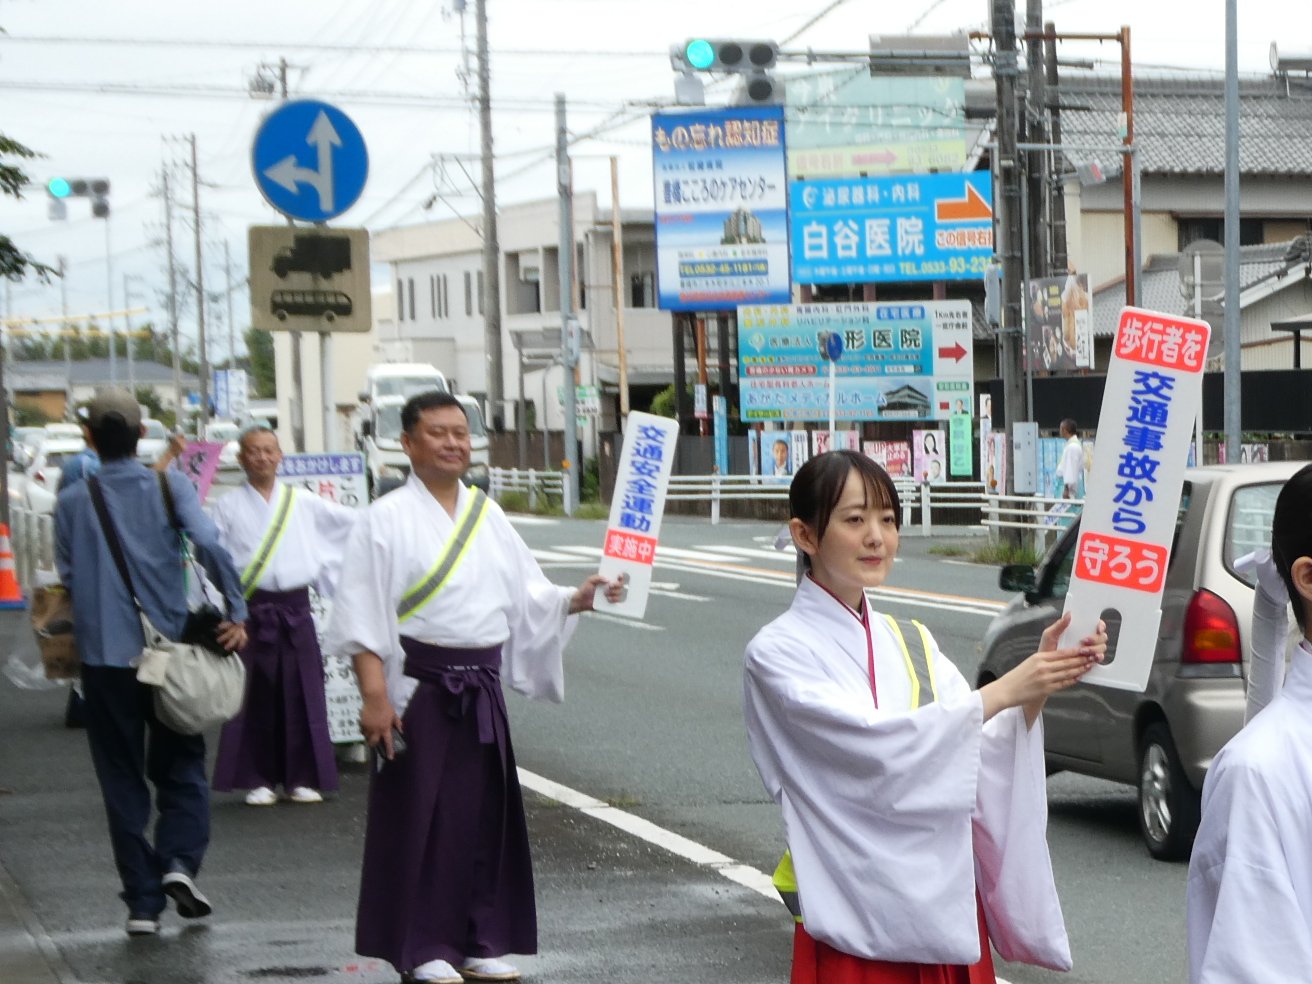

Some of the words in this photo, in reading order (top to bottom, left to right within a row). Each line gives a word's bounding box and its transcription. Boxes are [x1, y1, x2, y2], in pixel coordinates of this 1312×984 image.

[655, 119, 779, 152] もの忘れ認知症
[803, 216, 924, 260] 白谷医院
[1119, 316, 1204, 370] 歩行者を
[1109, 369, 1177, 536] 交通事故から
[618, 424, 668, 533] 交通安全運動
[608, 534, 652, 562] 実施中
[1080, 538, 1162, 587] 守ろう
